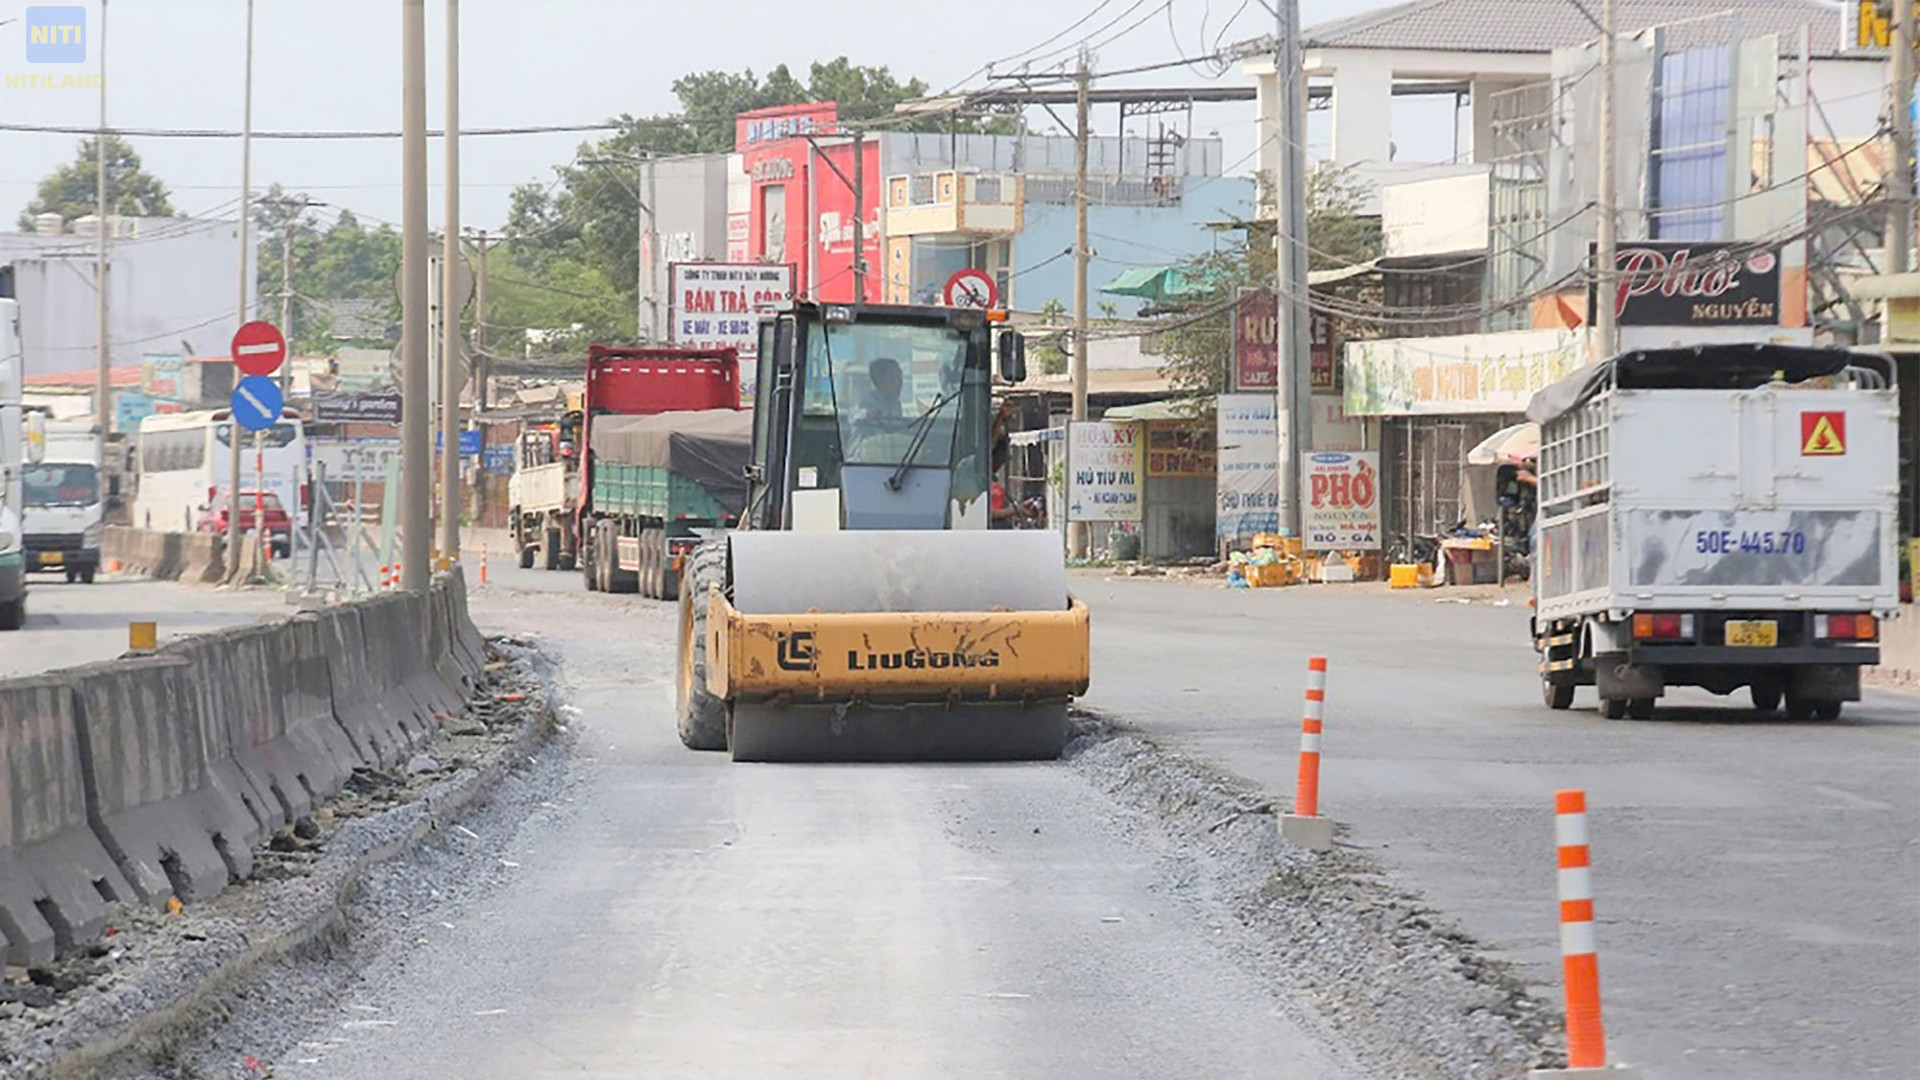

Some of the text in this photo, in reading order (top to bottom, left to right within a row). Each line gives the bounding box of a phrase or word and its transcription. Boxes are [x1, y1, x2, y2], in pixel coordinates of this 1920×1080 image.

[685, 286, 715, 313] BÁN
[720, 285, 748, 314] TRẢ
[1310, 459, 1375, 509] PHỞ
[1697, 531, 1806, 554] 50E-445.70
